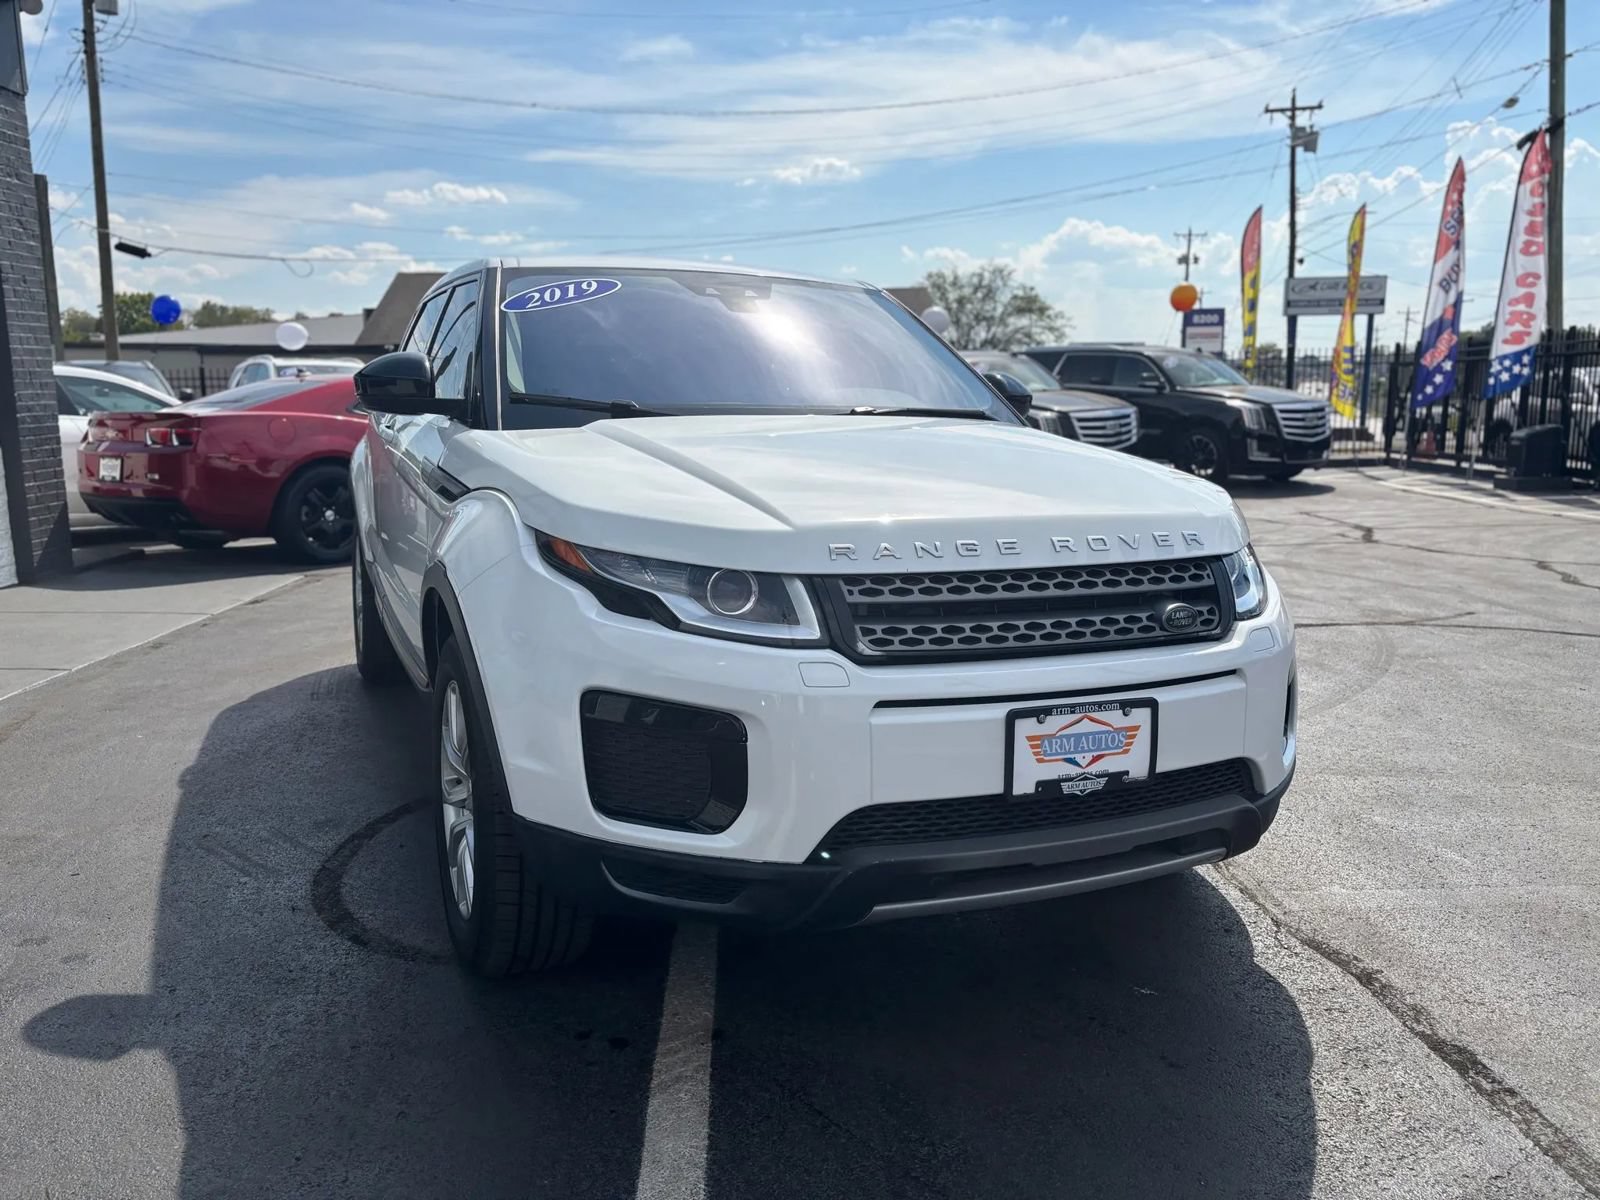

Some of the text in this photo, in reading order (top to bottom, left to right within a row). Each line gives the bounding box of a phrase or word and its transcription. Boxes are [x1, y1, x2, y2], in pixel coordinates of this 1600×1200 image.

[525, 280, 598, 309] 2019
[828, 530, 1205, 561] RANGE ROVER
[1051, 703, 1120, 715] arm-autos.com
[1042, 731, 1127, 753] ARM AUTOS
[1081, 780, 1102, 789] AUTOS
